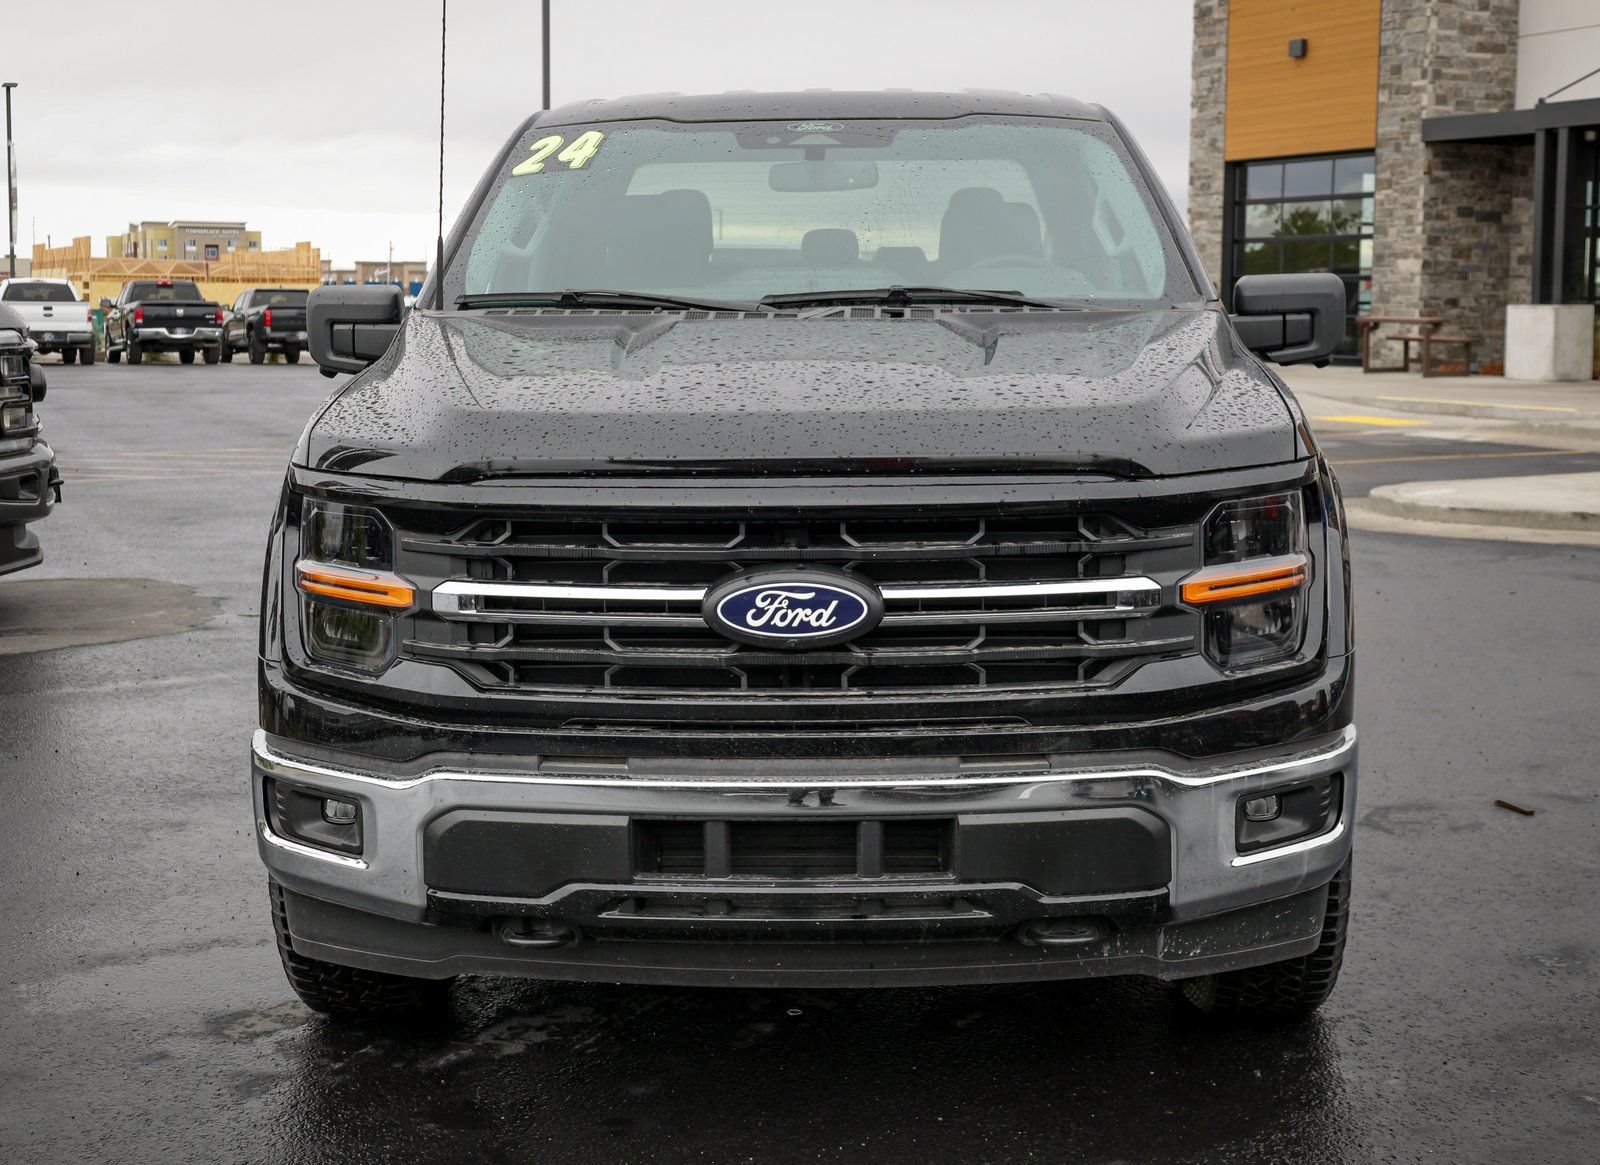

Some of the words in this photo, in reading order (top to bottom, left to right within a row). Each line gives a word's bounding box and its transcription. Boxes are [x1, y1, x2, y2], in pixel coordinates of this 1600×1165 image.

[797, 122, 835, 132] Ford
[512, 131, 604, 176] 24
[746, 590, 839, 628] Ford
